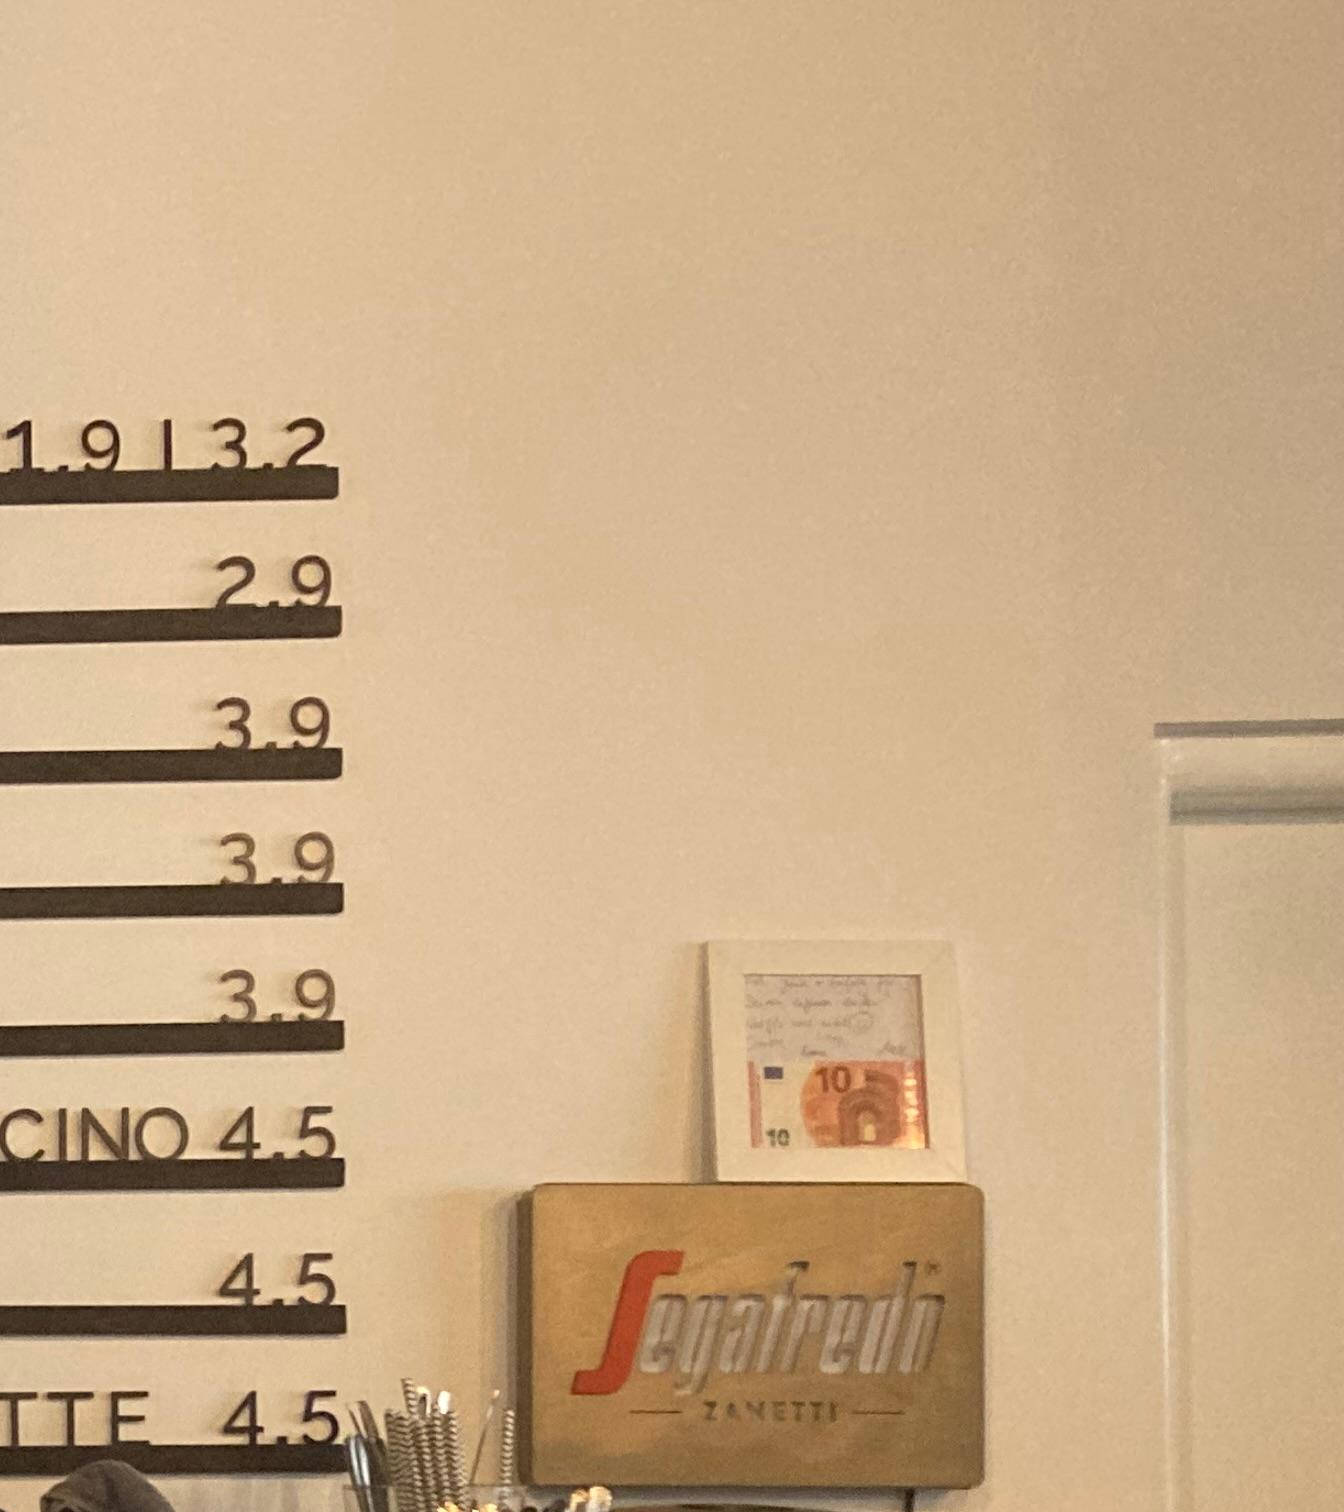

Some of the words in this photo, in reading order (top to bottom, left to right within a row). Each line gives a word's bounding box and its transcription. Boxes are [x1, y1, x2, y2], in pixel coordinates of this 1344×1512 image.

[215, 556, 333, 608] 2.9
[214, 697, 330, 749] 3.9
[220, 831, 336, 885] 3.9
[217, 969, 337, 1022] 3.9
[815, 1065, 851, 1093] 10
[218, 1106, 337, 1160] 4.5
[767, 1128, 790, 1147] 10
[218, 1253, 337, 1306] 4.5
[570, 1250, 945, 1396] Segafredo
[222, 1390, 341, 1445] 4.5
[703, 1400, 839, 1422] ZANETTI
